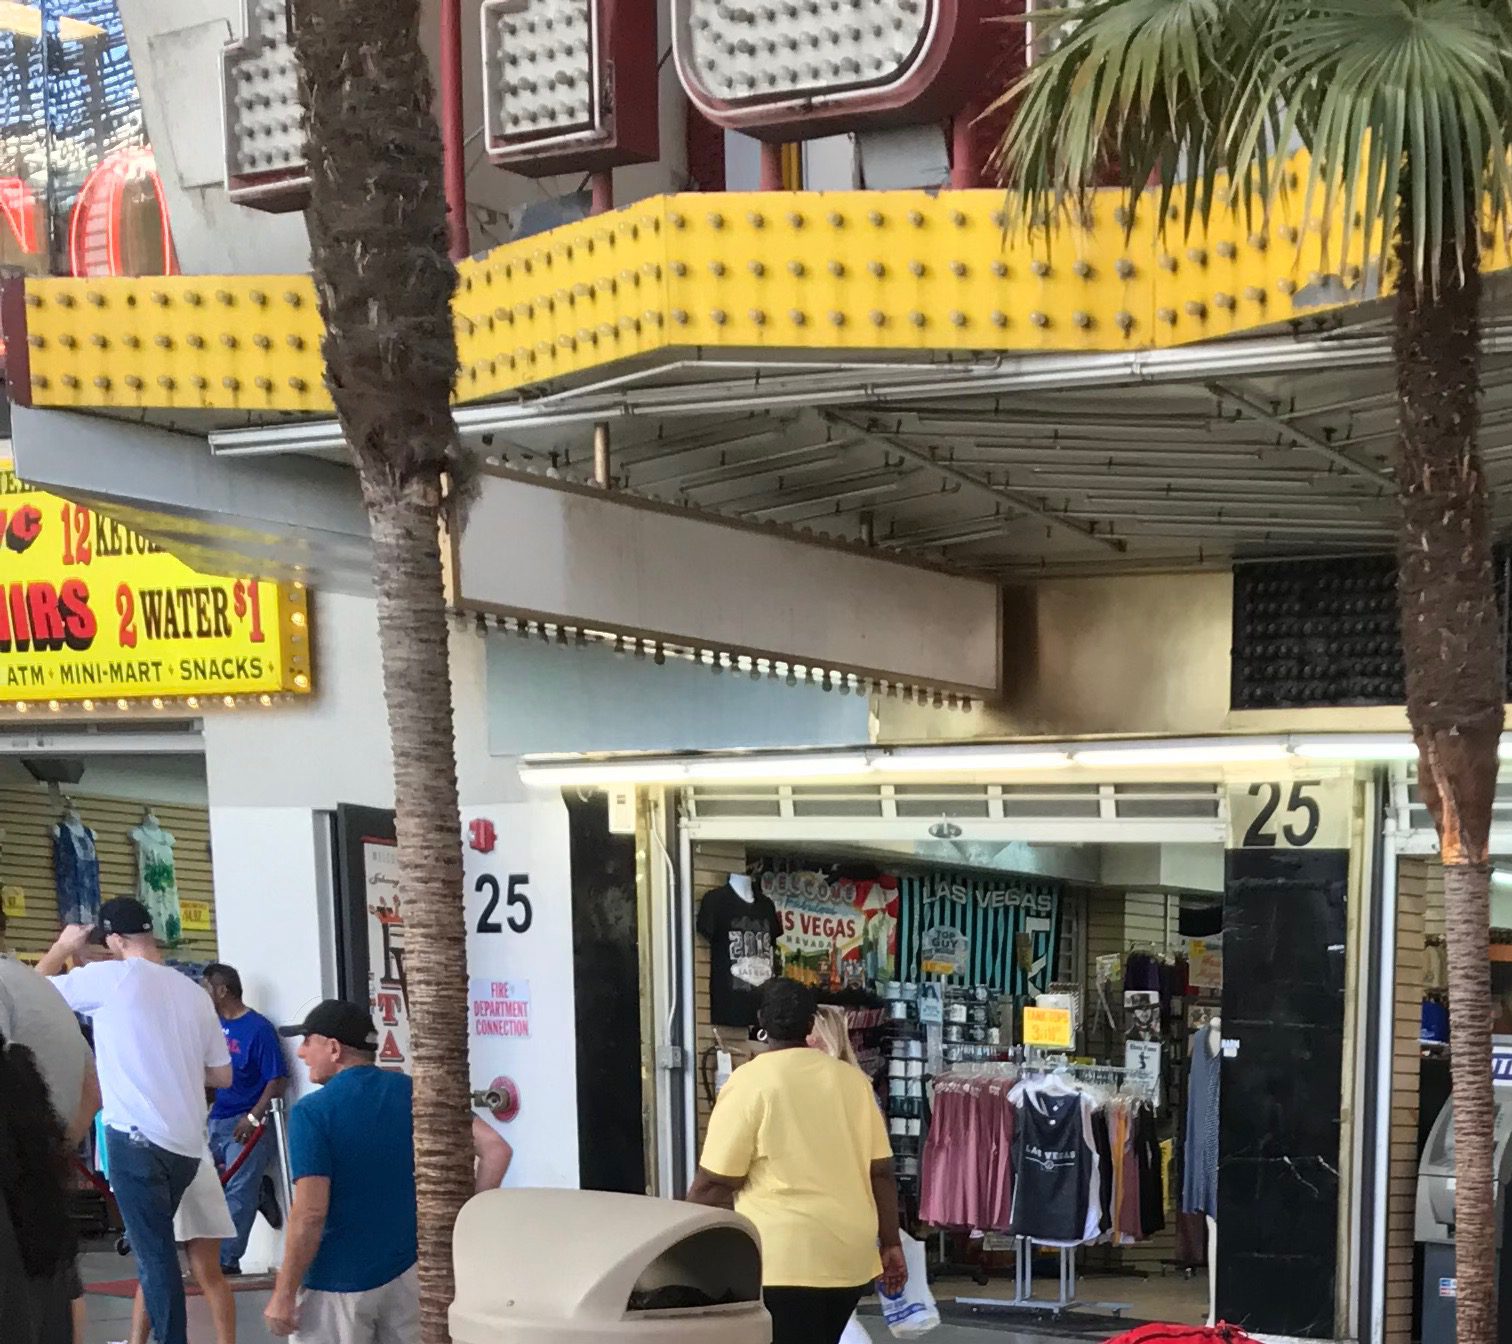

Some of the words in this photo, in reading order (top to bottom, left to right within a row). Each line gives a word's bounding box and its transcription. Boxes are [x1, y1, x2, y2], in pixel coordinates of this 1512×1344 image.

[61, 502, 92, 566] 12
[115, 581, 137, 648] 2
[139, 586, 232, 640] WATER
[233, 577, 265, 643] $1
[7, 664, 45, 686] ATM
[59, 661, 163, 683] MINI-MART
[179, 657, 264, 681] SNACKS
[1243, 781, 1321, 847] 25
[474, 873, 533, 934] 25
[922, 881, 967, 905] LAS
[975, 888, 1052, 911] VEGAS
[800, 913, 856, 939] VEGAS
[491, 982, 509, 998] FIRE
[474, 1001, 528, 1017] DEPARTMENT
[476, 1019, 529, 1036] CONNECTION
[1025, 1144, 1042, 1158] LAS
